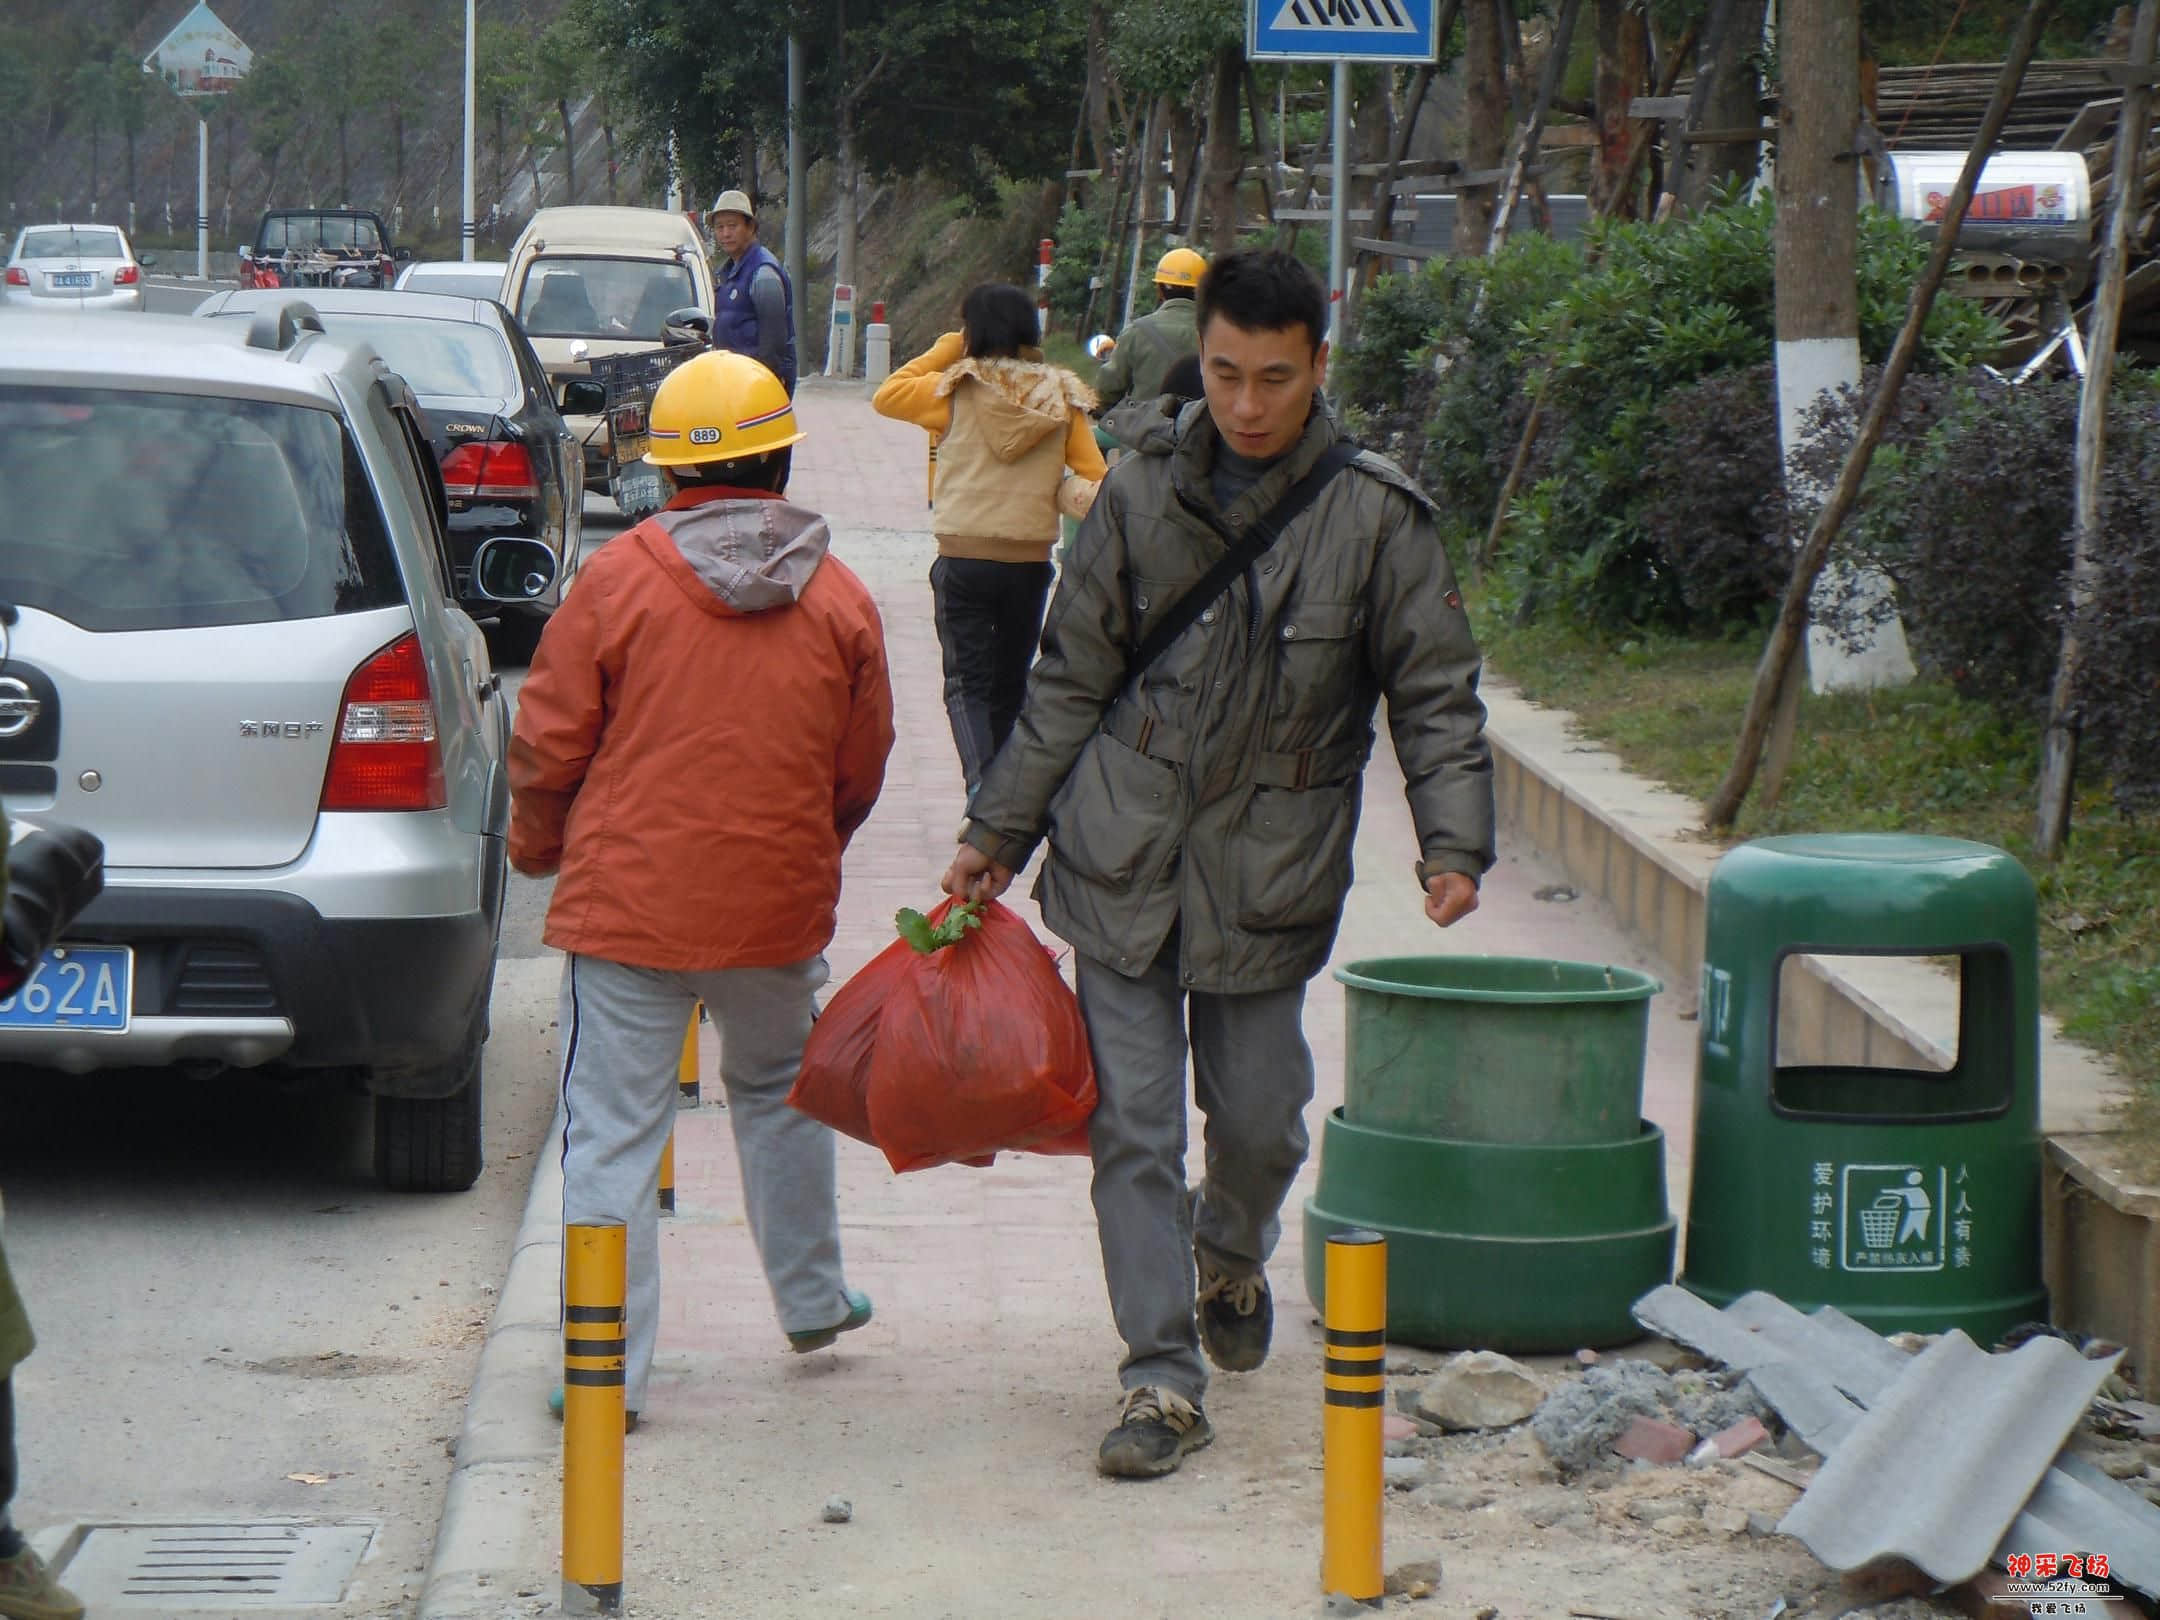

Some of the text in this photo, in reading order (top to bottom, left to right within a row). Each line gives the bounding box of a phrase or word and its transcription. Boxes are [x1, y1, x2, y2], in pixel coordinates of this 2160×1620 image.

[445, 423, 485, 433] CROWN
[694, 429, 717, 442] 889
[239, 719, 324, 739] 东风日产
[1811, 1163, 1833, 1269] 爱护环境
[1954, 1163, 1973, 1268] 人人有责
